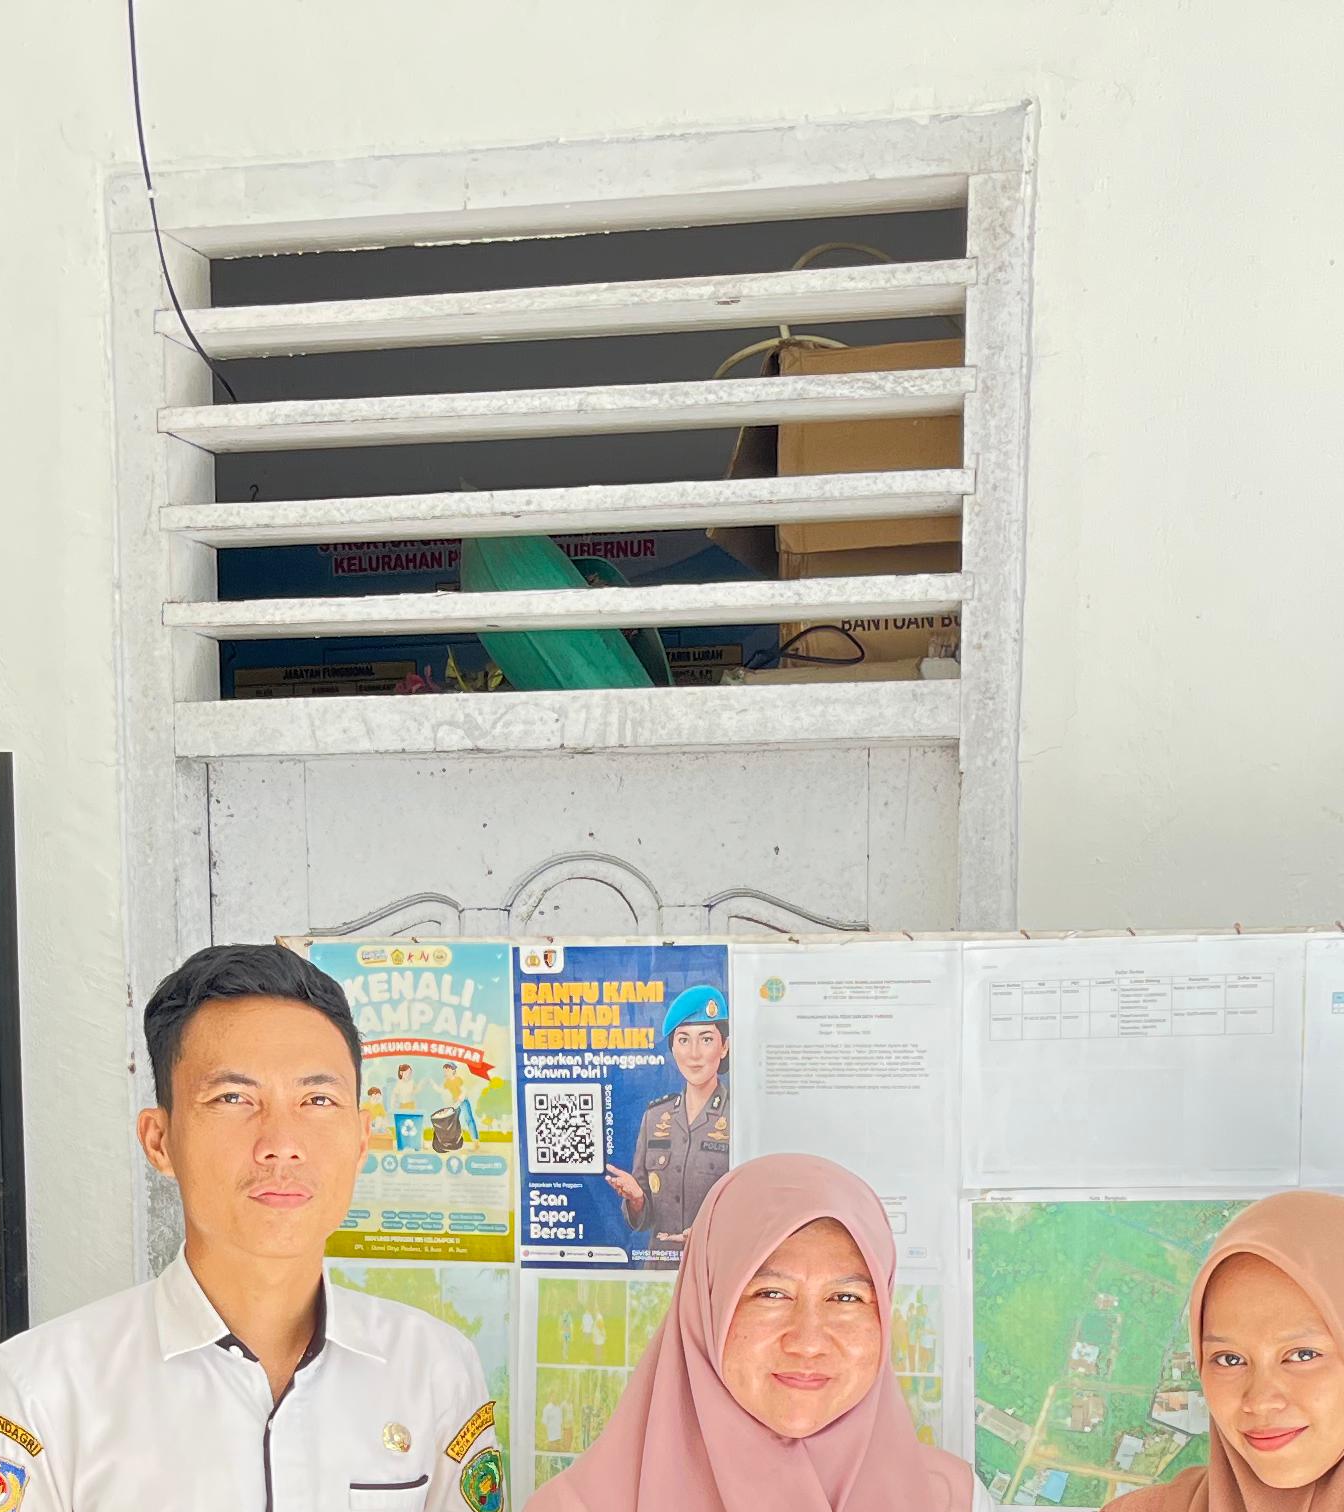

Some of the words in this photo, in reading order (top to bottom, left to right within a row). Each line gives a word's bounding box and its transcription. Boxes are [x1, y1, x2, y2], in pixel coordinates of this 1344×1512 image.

[333, 551, 442, 575] KELURAHAN
[344, 970, 475, 1007] KENALI
[521, 982, 599, 1004] BANTU
[603, 981, 664, 1003] KAMI
[358, 1001, 487, 1043] AMPAH
[522, 1005, 620, 1027] MENJADI
[523, 1028, 587, 1050] LEBIH
[591, 1028, 654, 1050] BAIK!
[430, 1044, 481, 1063] SEKITAR
[523, 1053, 582, 1070] Laporkan
[584, 1053, 665, 1069] Pelanggaran
[524, 1066, 570, 1079] Oknum
[573, 1065, 601, 1079] Polri
[604, 1084, 613, 1110] Scan
[605, 1111, 614, 1126] QR
[606, 1127, 614, 1155] Code
[529, 1190, 568, 1206] Scan
[529, 1207, 575, 1227] Lapor
[529, 1225, 575, 1240] Beres
